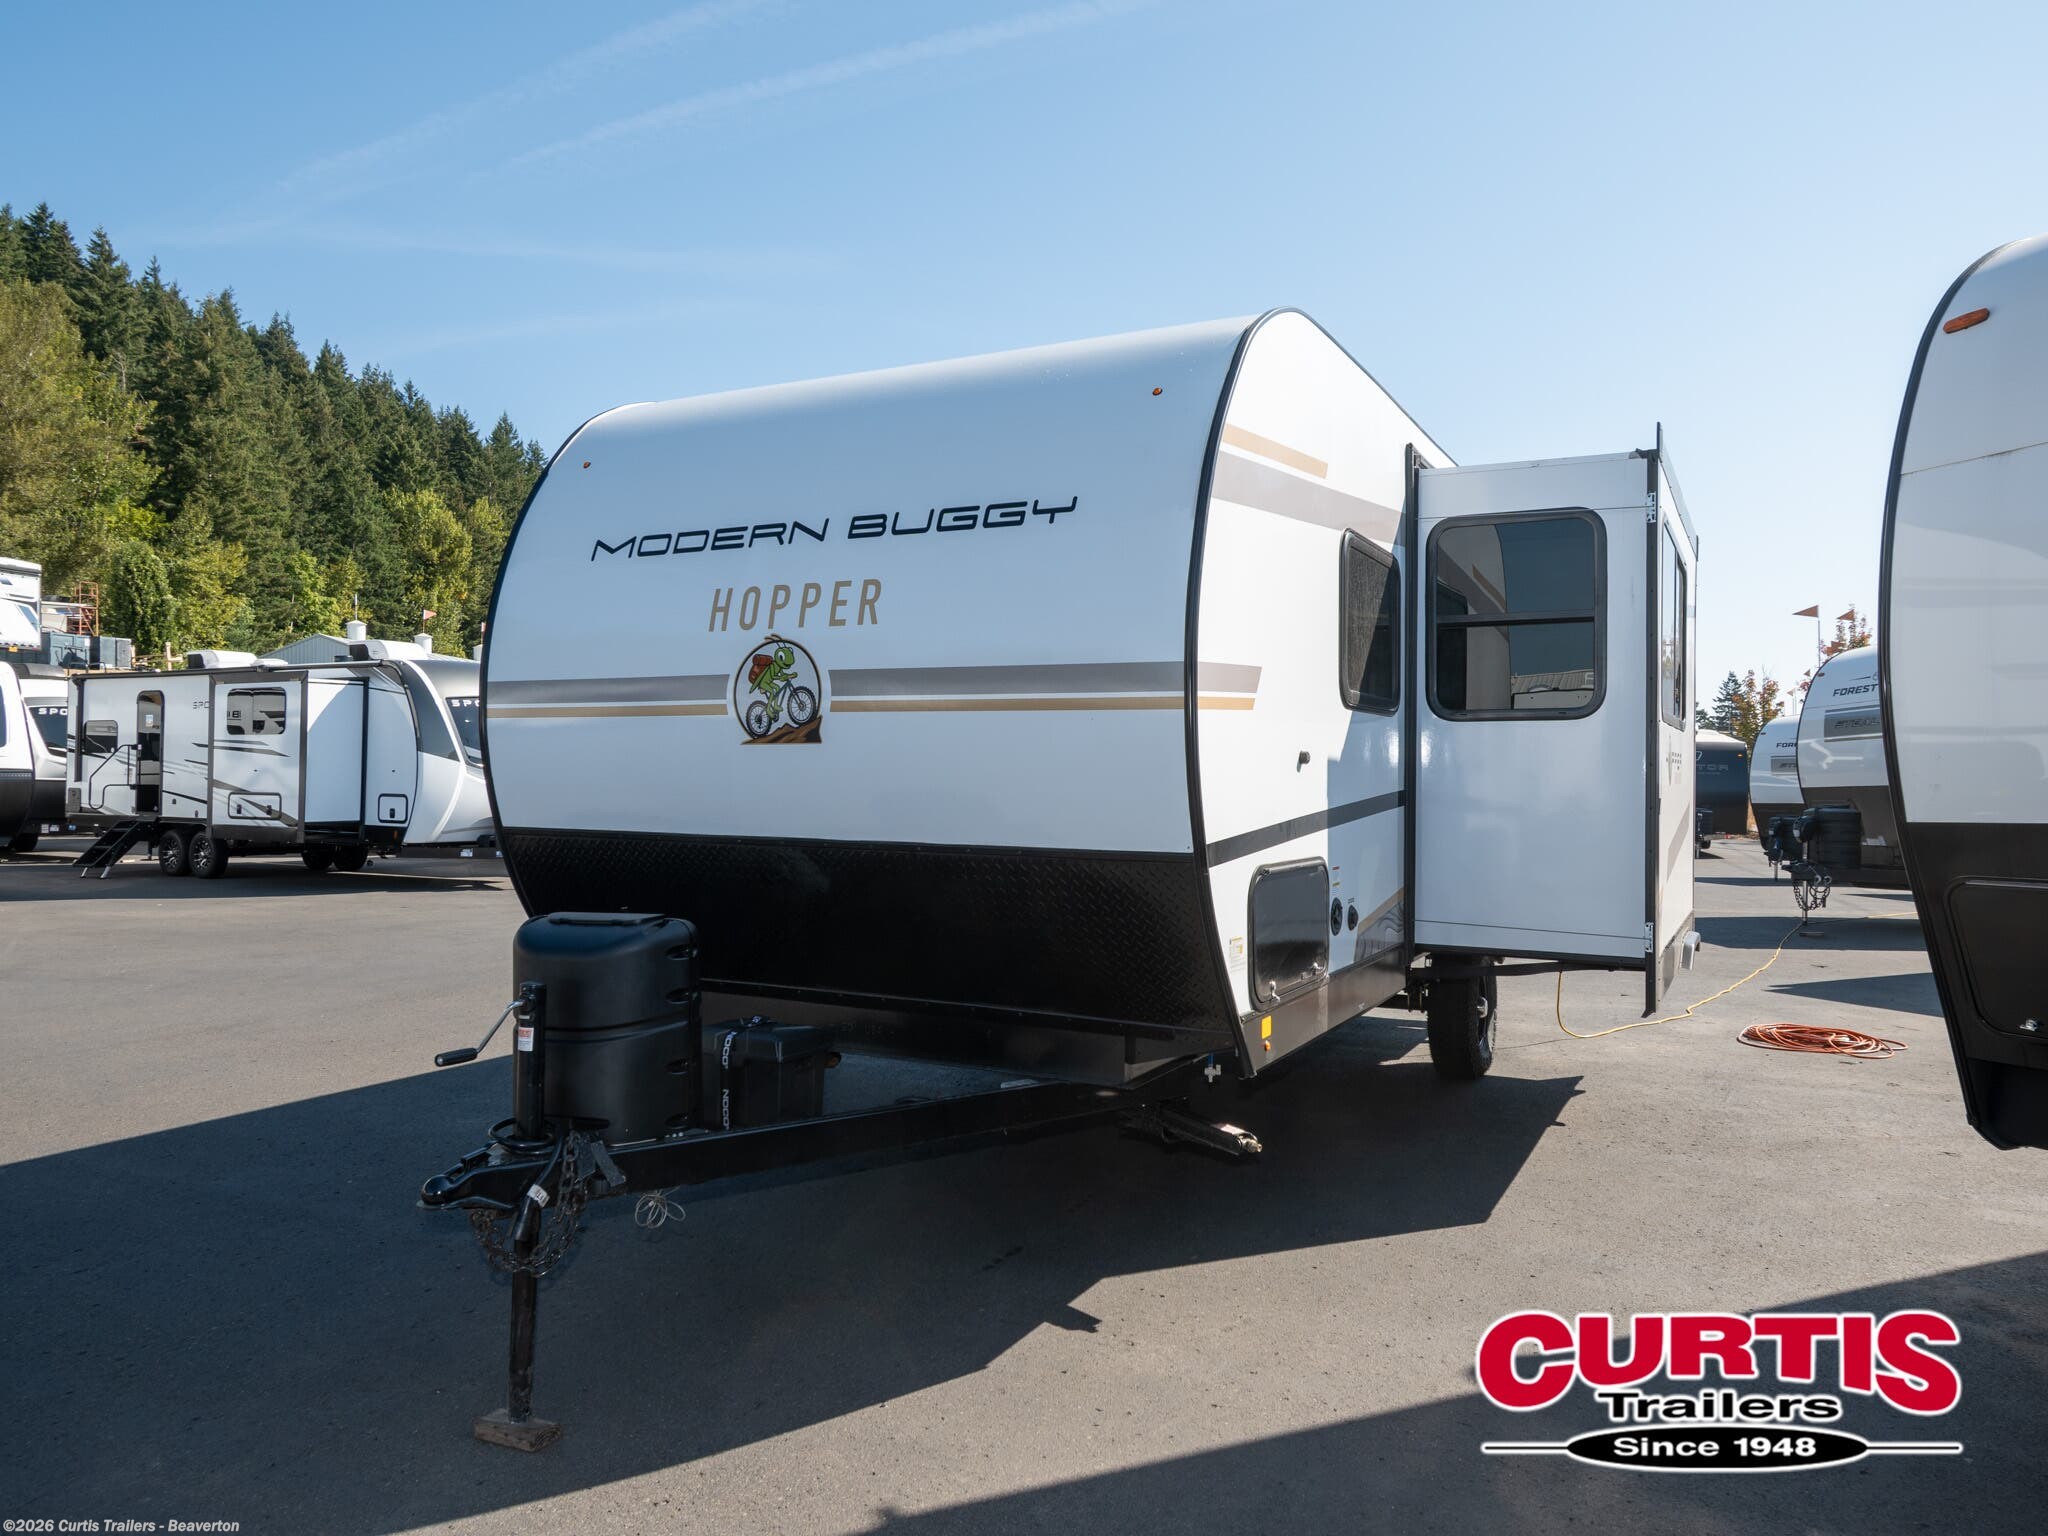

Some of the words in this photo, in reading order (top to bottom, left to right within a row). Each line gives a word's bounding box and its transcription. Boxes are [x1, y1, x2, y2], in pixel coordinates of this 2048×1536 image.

[591, 518, 829, 561] MODERN
[847, 496, 1078, 539] BUGGY
[708, 578, 882, 632] HOPPER
[1833, 683, 1879, 696] FOREST
